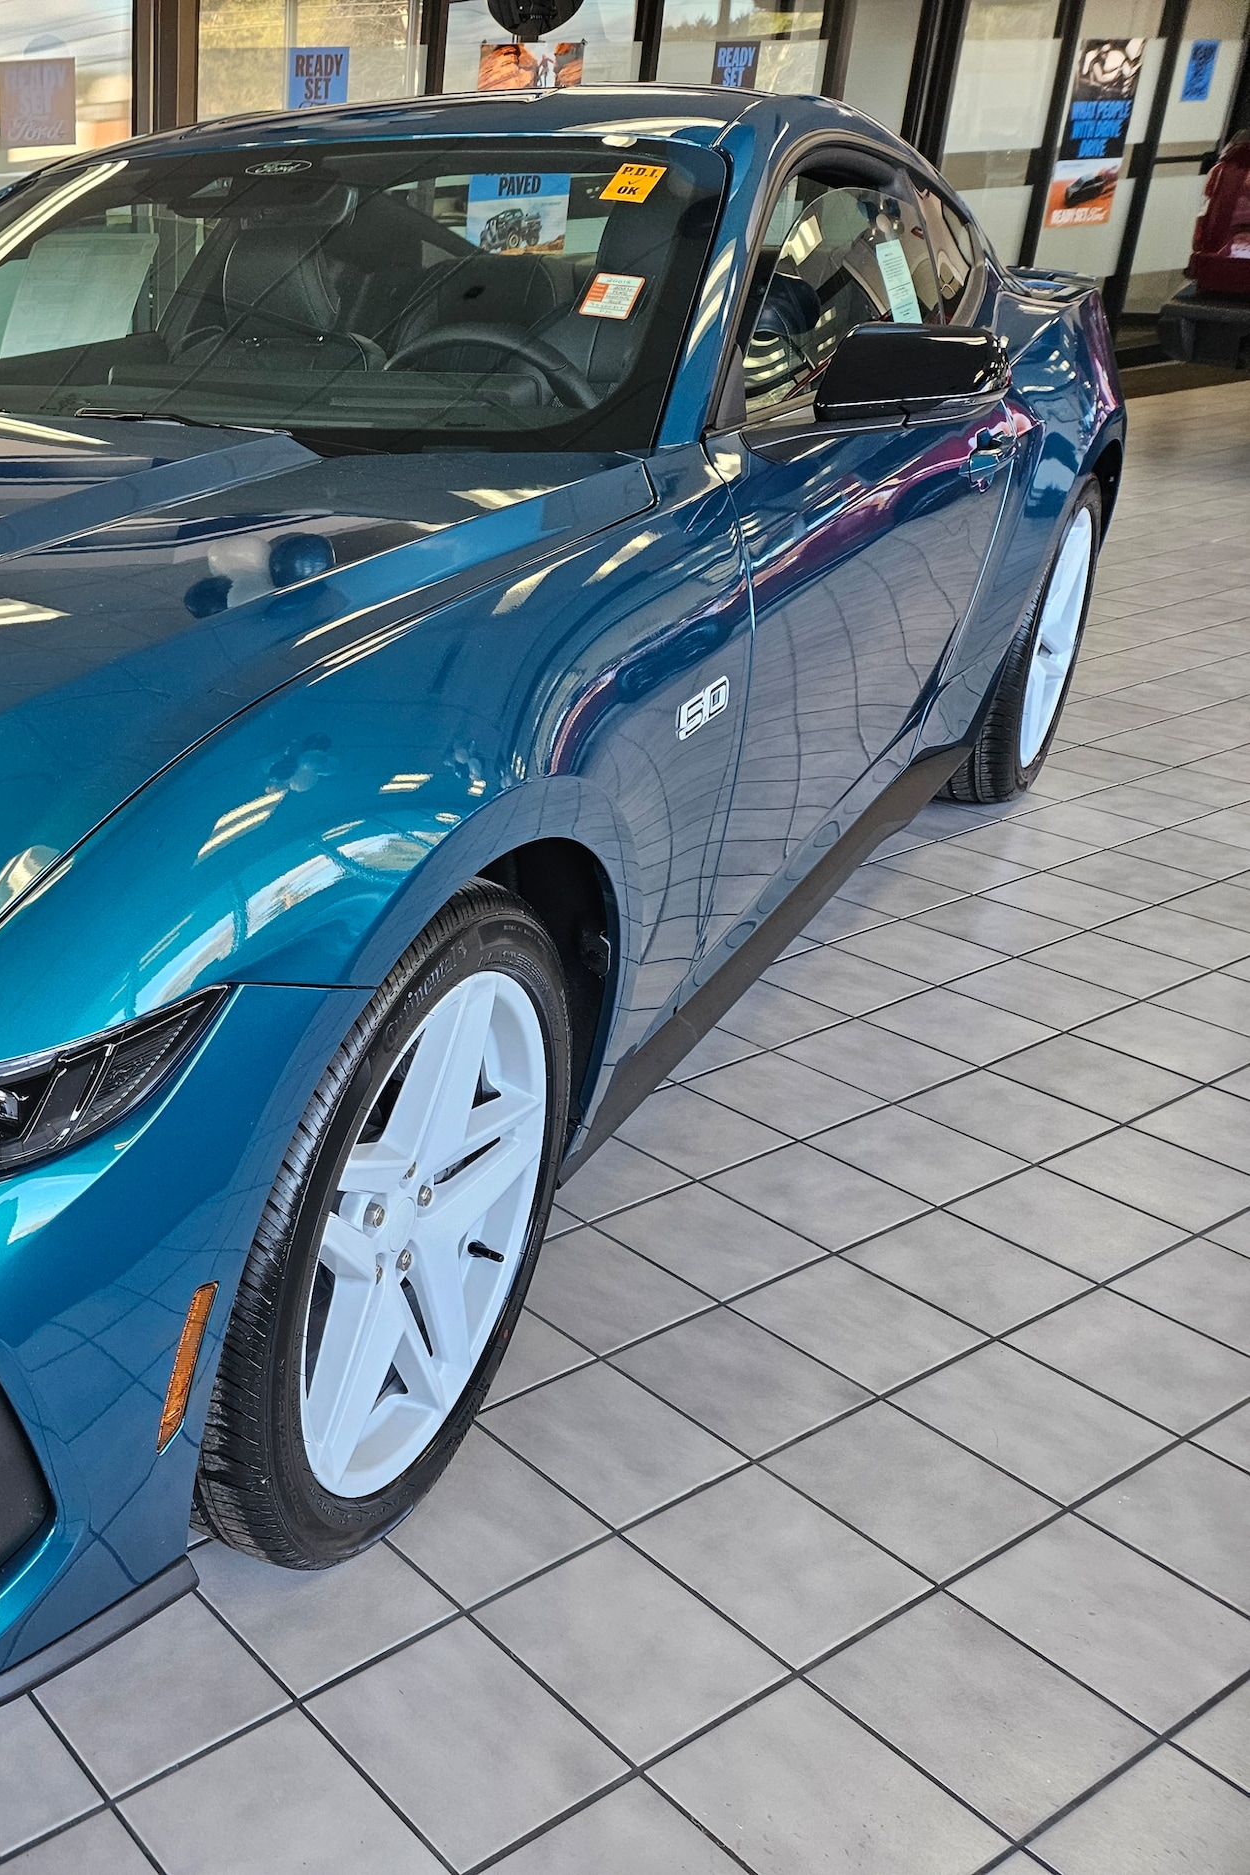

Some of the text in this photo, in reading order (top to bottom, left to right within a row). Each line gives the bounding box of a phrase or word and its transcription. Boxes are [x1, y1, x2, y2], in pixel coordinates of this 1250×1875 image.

[295, 54, 343, 77] READY
[717, 46, 756, 67] READY
[722, 66, 745, 87] SET
[304, 78, 331, 99] SET
[621, 166, 658, 178] P.D.I.
[498, 175, 541, 196] PAVED
[617, 186, 639, 195] OK
